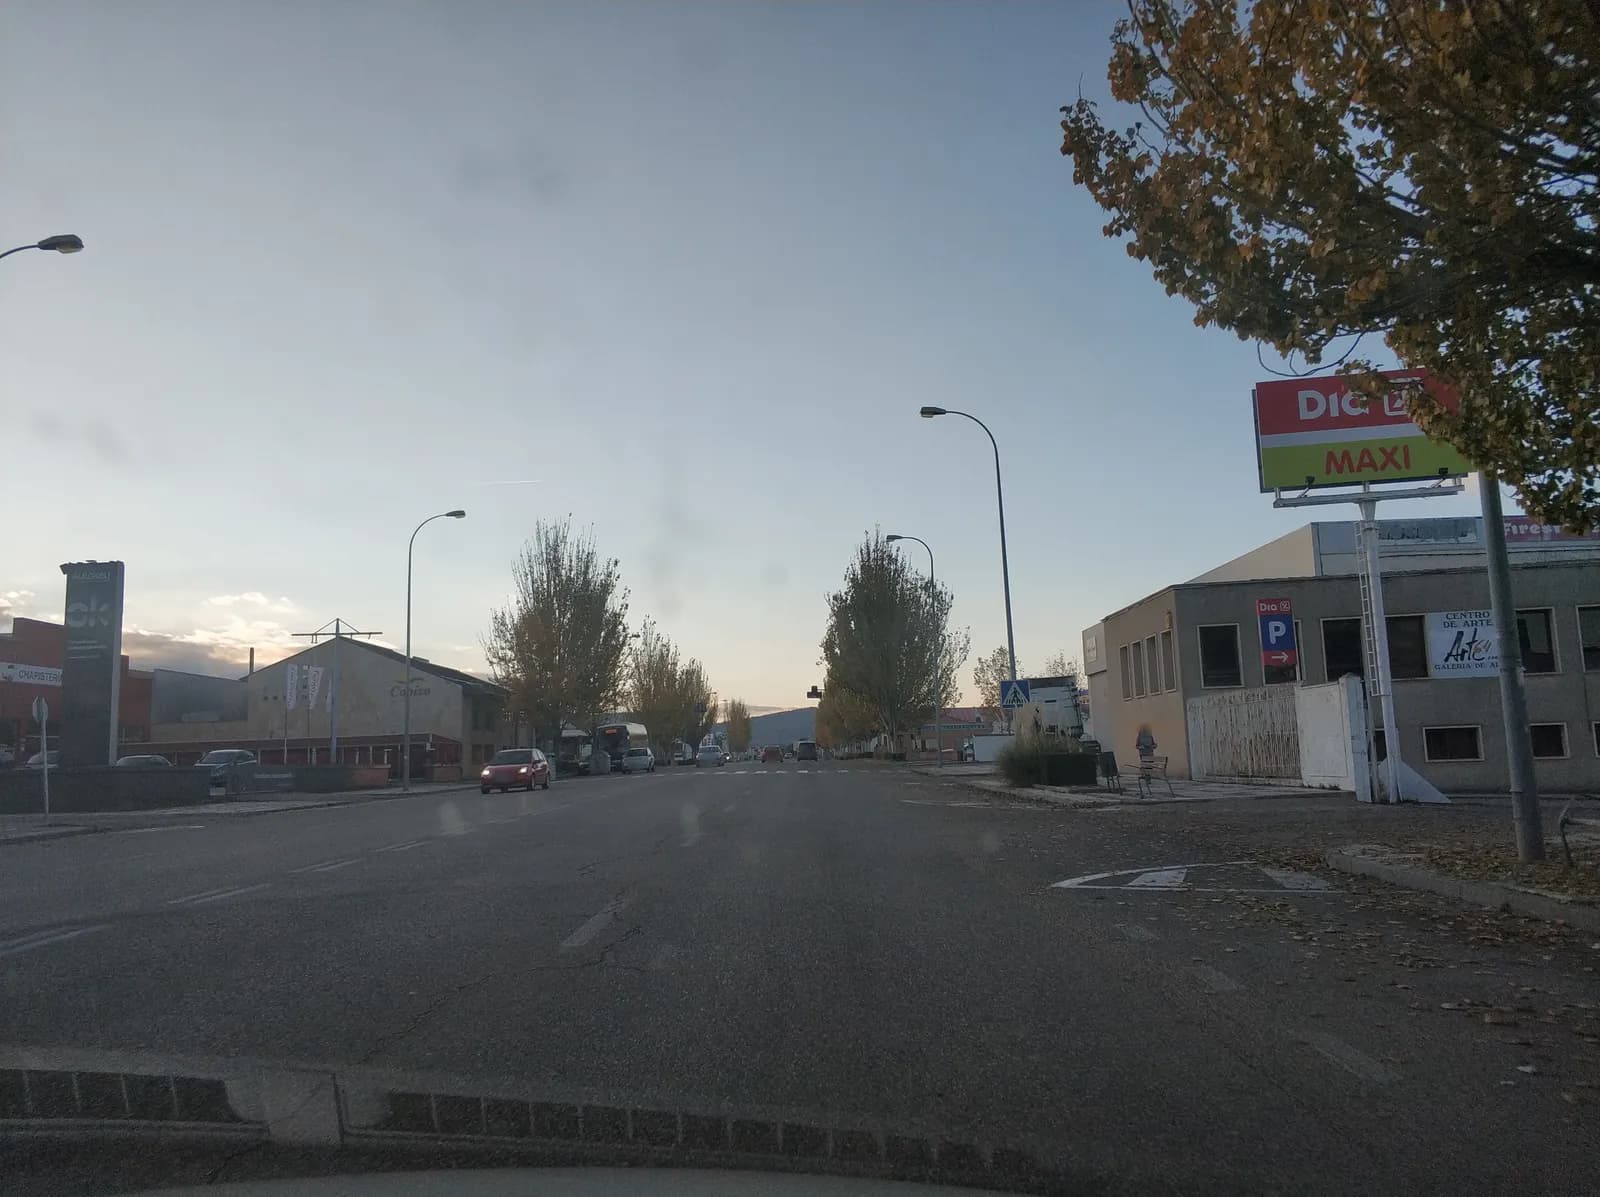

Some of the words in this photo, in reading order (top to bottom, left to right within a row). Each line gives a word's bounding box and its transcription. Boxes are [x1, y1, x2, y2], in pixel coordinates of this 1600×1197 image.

[1324, 444, 1412, 477] MAXI
[1446, 611, 1490, 620] CENTRO
[1464, 619, 1494, 627] ARTE
[1268, 620, 1287, 645] P
